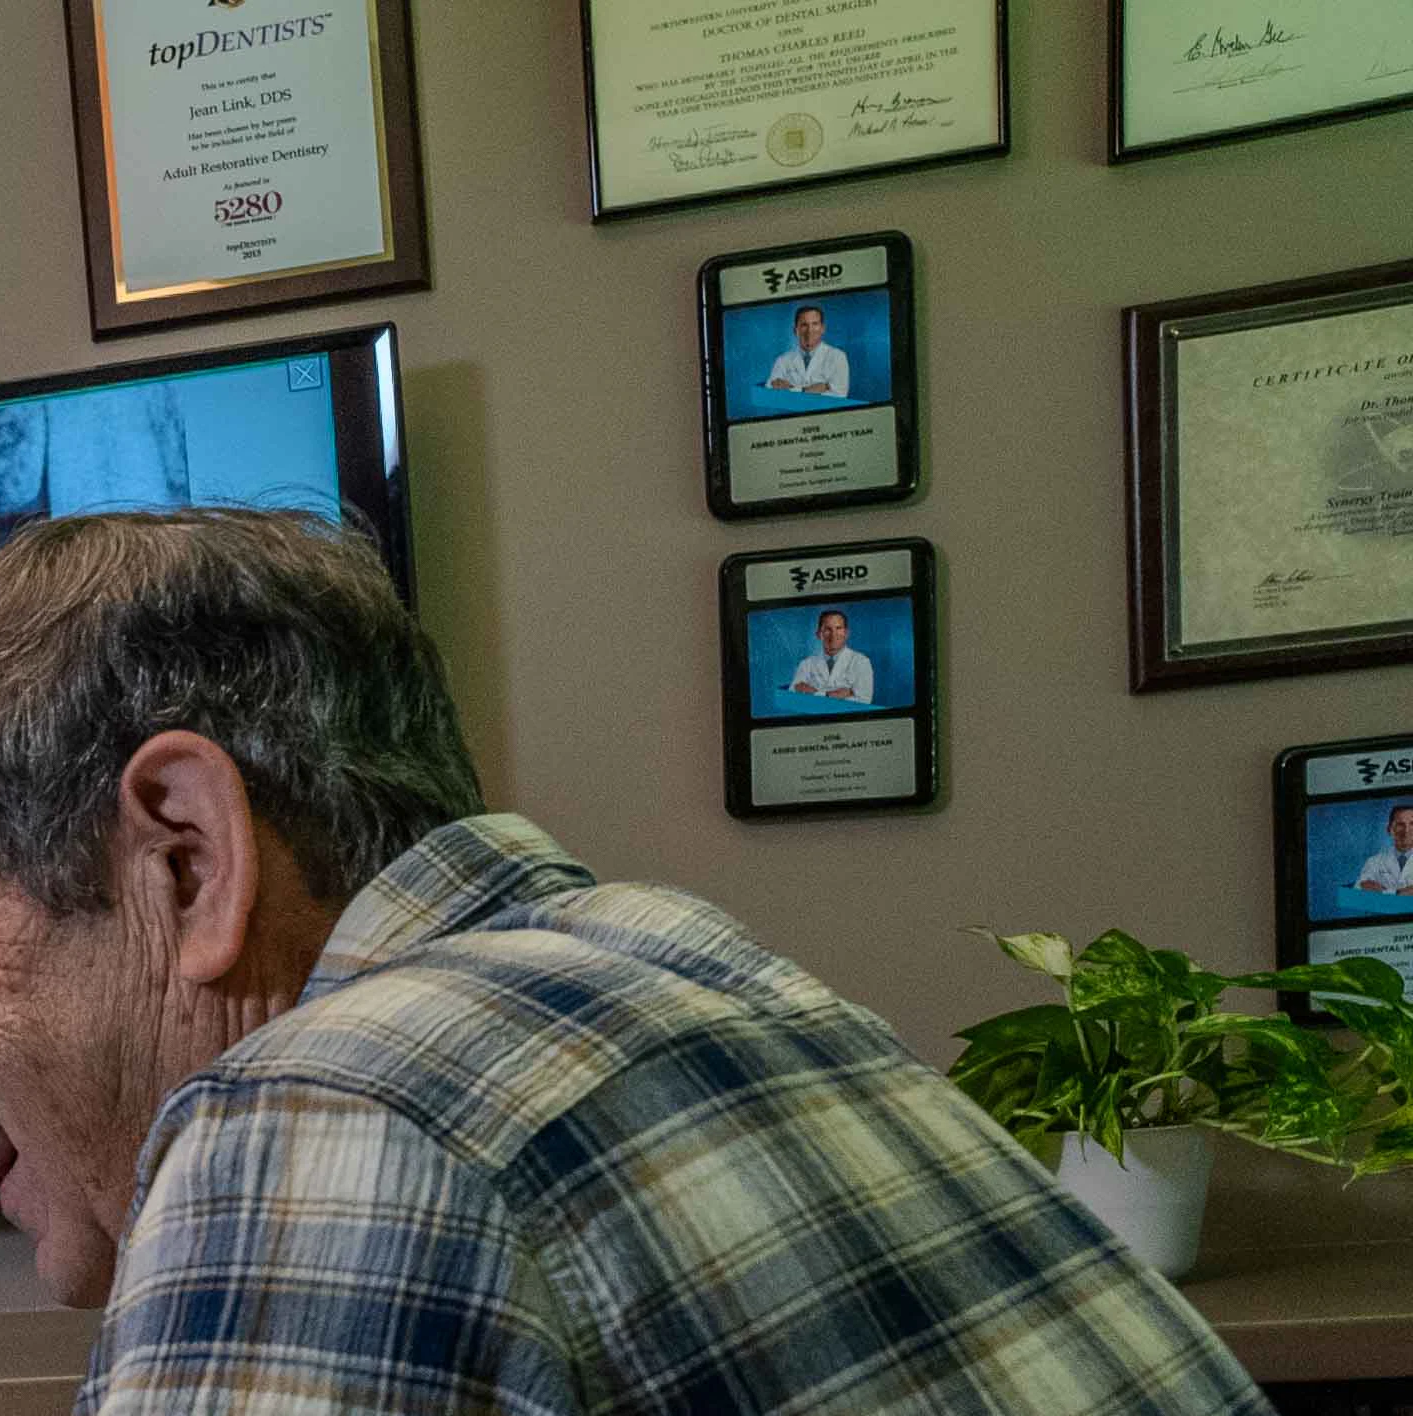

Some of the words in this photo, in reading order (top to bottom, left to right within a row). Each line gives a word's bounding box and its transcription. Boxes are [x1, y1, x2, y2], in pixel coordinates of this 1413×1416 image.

[702, 20, 752, 39] DOCTOR
[755, 17, 771, 30] OF
[775, 7, 823, 26] DENTAL
[718, 46, 770, 64] THOMAS
[773, 36, 829, 55] CHARLES
[832, 28, 866, 44] REED
[190, 103, 218, 120] Jean
[222, 95, 256, 113] Link,
[260, 87, 292, 105] DDS
[162, 165, 197, 181] Adult
[201, 152, 269, 175] Restorative
[272, 144, 329, 162] Dentistry
[214, 191, 283, 224] 5280
[786, 263, 843, 284] ASIRD
[1253, 358, 1388, 389] CERTIFICATE
[1325, 495, 1374, 509] Synergy
[812, 565, 869, 584] ASIRD
